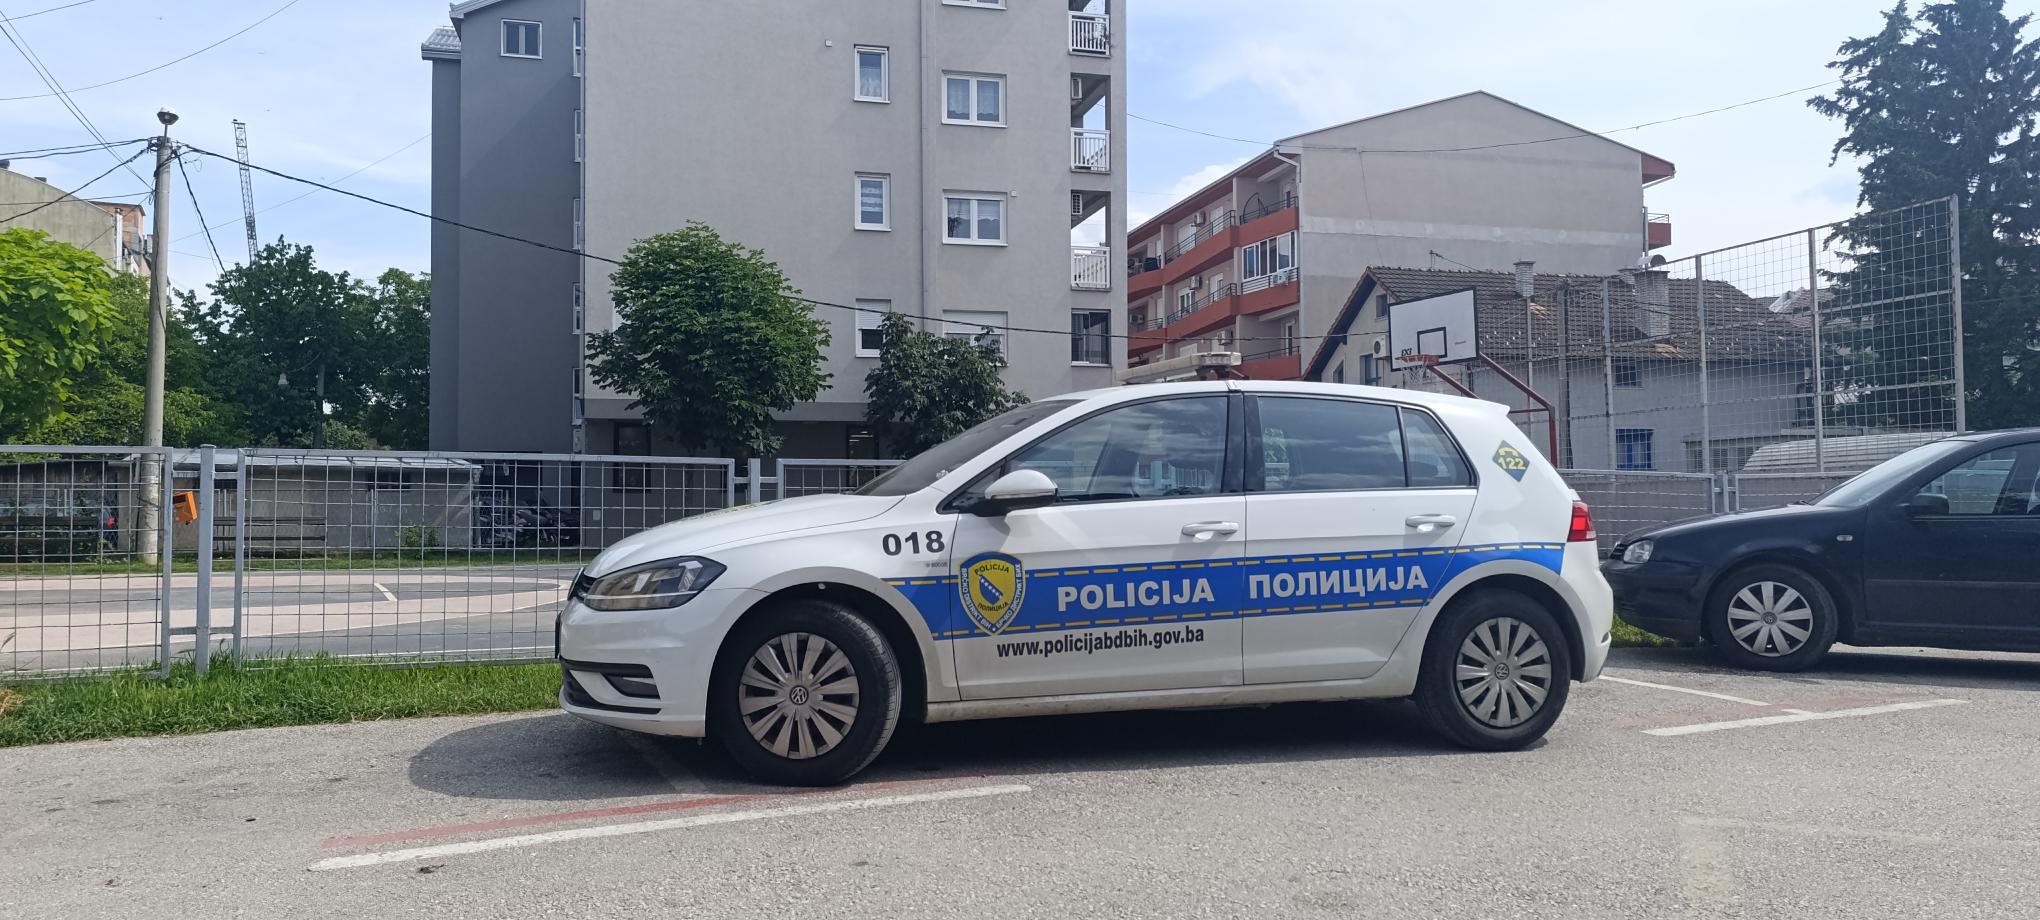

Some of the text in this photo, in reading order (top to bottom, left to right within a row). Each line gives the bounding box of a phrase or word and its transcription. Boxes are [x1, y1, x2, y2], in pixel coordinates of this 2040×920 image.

[1498, 457, 1526, 470] 122
[882, 530, 945, 556] 018
[974, 563, 1010, 575] POLICIJA
[1249, 565, 1428, 599] ПОЛИЦИЈА
[977, 601, 1010, 612] ПОЛИЦИЈА
[1057, 578, 1215, 611] POLICIJA
[996, 625, 1204, 658] www.policijabdbih.gov.ba
